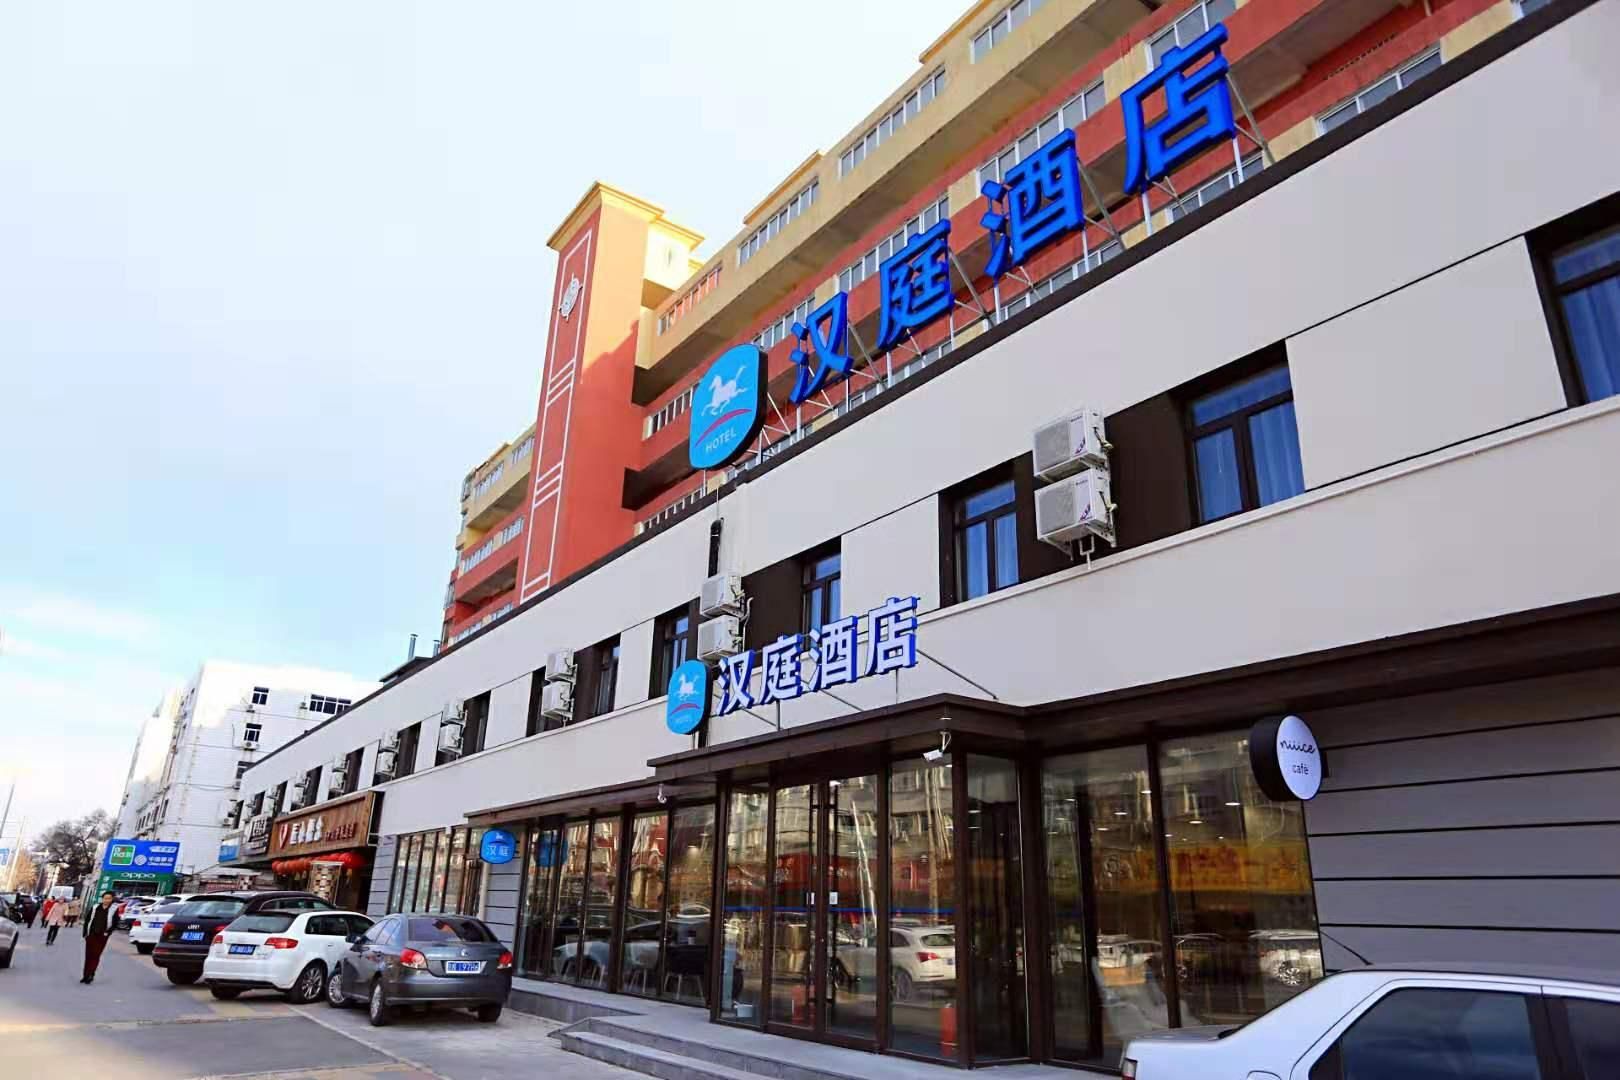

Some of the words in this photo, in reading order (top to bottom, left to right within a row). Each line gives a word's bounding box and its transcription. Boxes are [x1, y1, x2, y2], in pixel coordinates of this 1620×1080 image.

[790, 22, 1236, 405] 汉庭酒店
[705, 427, 737, 453] HOTEL
[716, 596, 918, 716] 汉庭酒店
